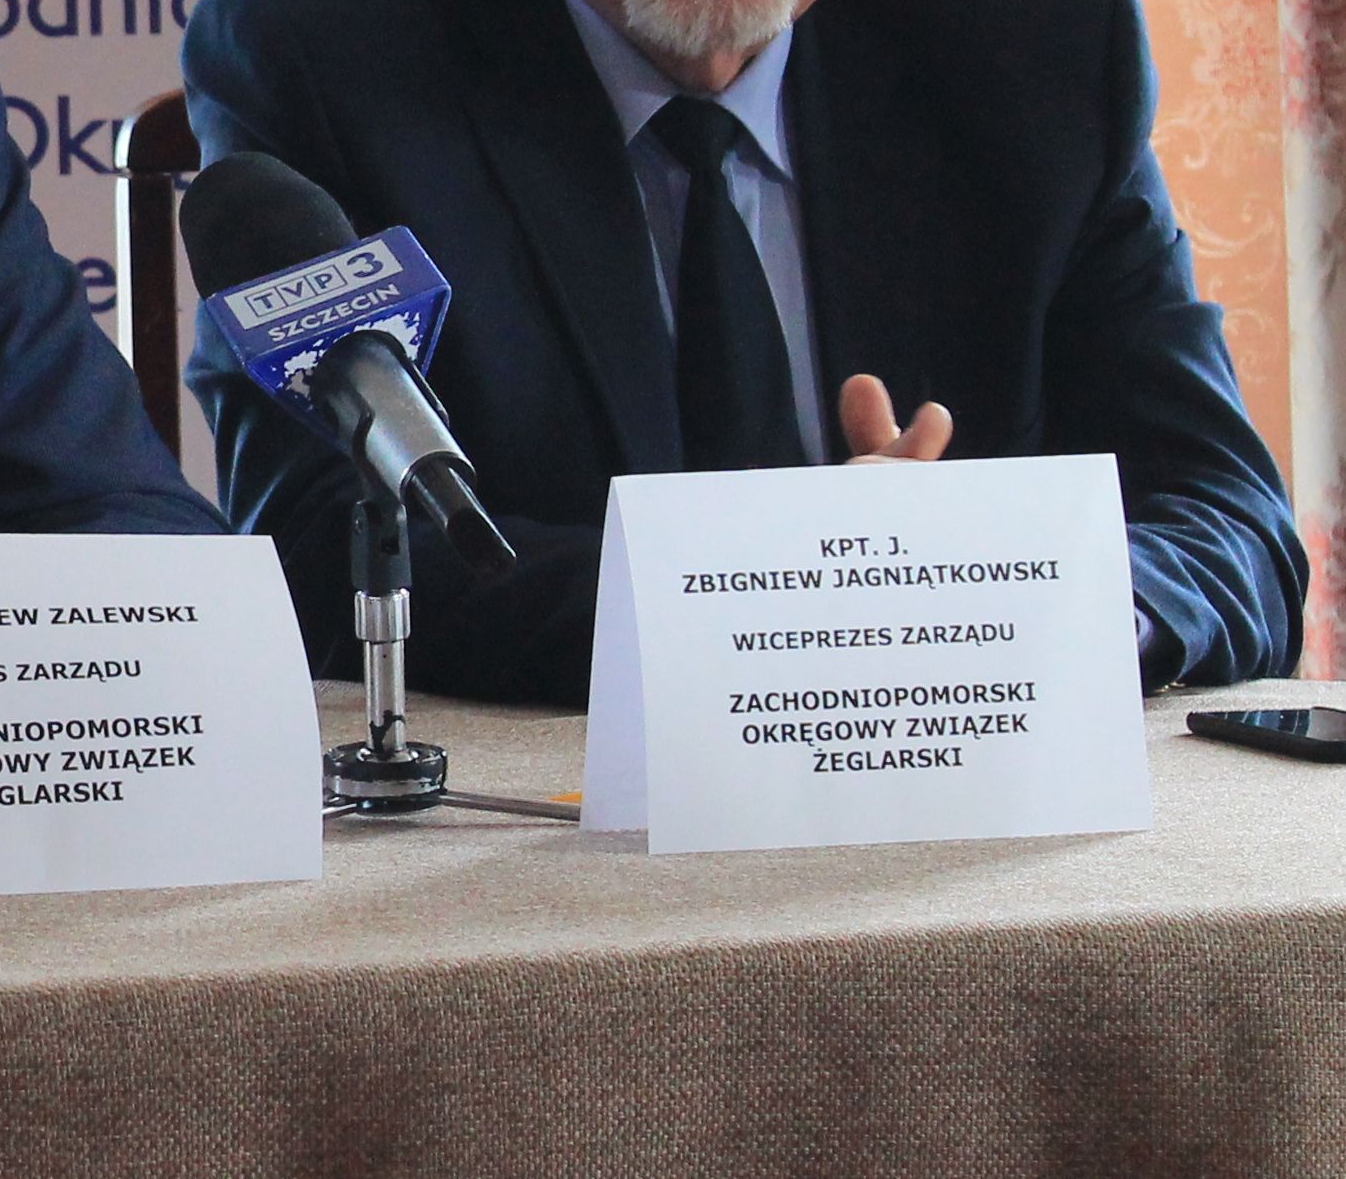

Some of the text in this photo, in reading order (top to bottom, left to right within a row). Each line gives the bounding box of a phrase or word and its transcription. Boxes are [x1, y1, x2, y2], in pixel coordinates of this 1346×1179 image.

[250, 252, 384, 311] TVP 3
[268, 283, 401, 342] SZCZECIN
[820, 536, 909, 559] KPT. J.
[682, 561, 1060, 594] ZBIGNIEW JAGNIĄTKOWSKI
[49, 605, 199, 626] ZALEWSKI
[733, 623, 1016, 652] WICEPREZES ZARZĄDU
[16, 659, 142, 683] ZARZĄDU
[729, 682, 1037, 714] ZACHODNIOPOMORSKI
[742, 713, 1029, 747] OKRĘGOWY ZWIĄZEK
[60, 746, 196, 772] ZWIĄZEK
[813, 747, 963, 773] ŻEGLARSKI
